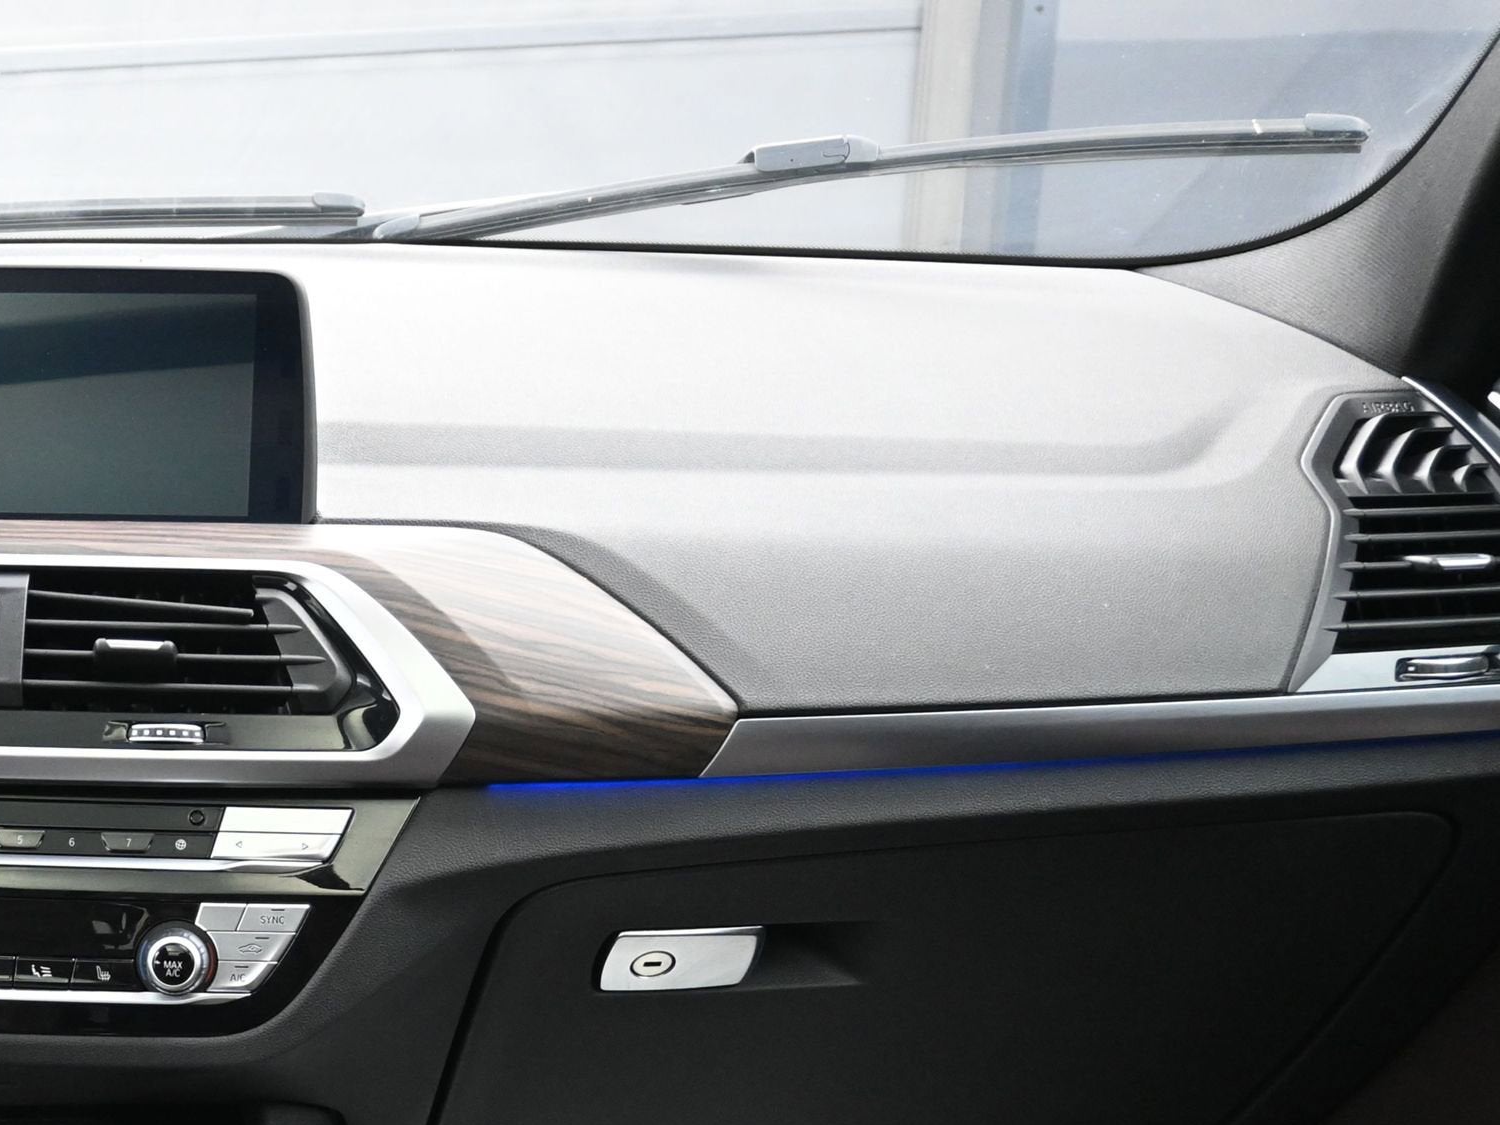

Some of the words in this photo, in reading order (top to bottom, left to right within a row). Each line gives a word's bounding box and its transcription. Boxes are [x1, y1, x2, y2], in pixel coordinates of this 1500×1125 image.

[260, 915, 285, 925] SYNC
[163, 960, 183, 969] MAX
[165, 968, 181, 978] A/C
[229, 973, 246, 982] A/C
